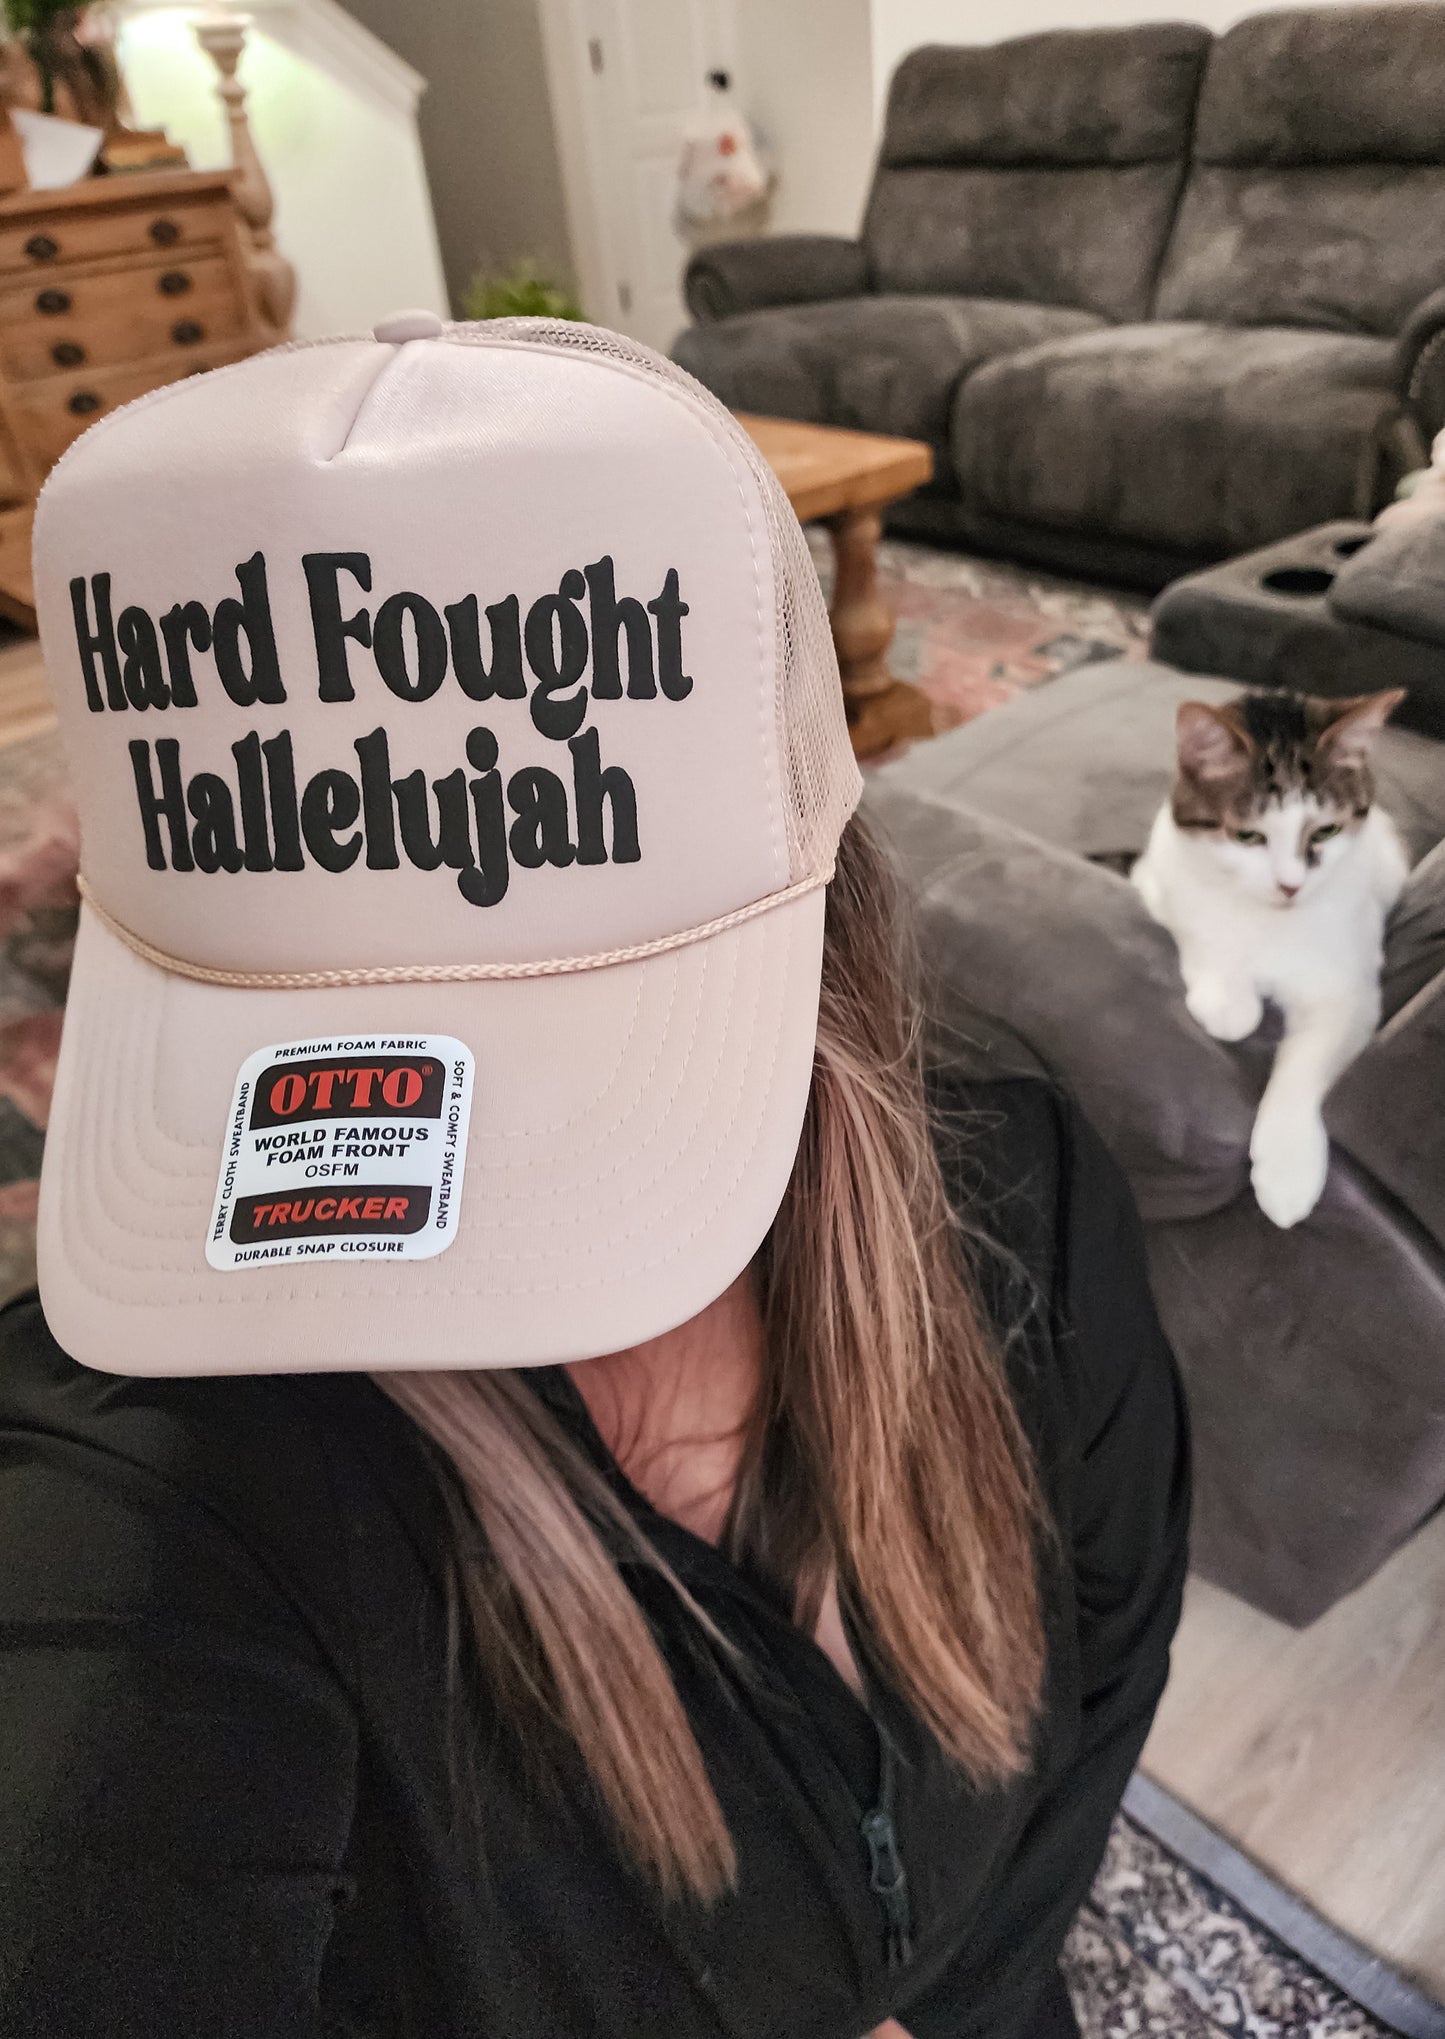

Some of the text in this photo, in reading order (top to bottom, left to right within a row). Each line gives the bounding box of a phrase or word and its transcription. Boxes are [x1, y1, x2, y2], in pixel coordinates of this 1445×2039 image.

[69, 551, 693, 740] Hard Fought
[129, 726, 640, 906] Hallelujah
[275, 1040, 427, 1058] PREMIUM FOAM FABRIC
[452, 1060, 465, 1087] SOFT
[255, 1128, 429, 1152] WORLD FAMOUS
[446, 1105, 459, 1147] COMFY
[213, 1082, 250, 1241] TERRY CLOTH SWEATBAND
[267, 1144, 410, 1166] FOAM FRONT
[305, 1163, 359, 1177] OSFM
[437, 1152, 455, 1229] SWEATBAND
[253, 1197, 409, 1228] TRUCKER
[235, 1242, 404, 1262] DURABLE SNAP CLOSURE
